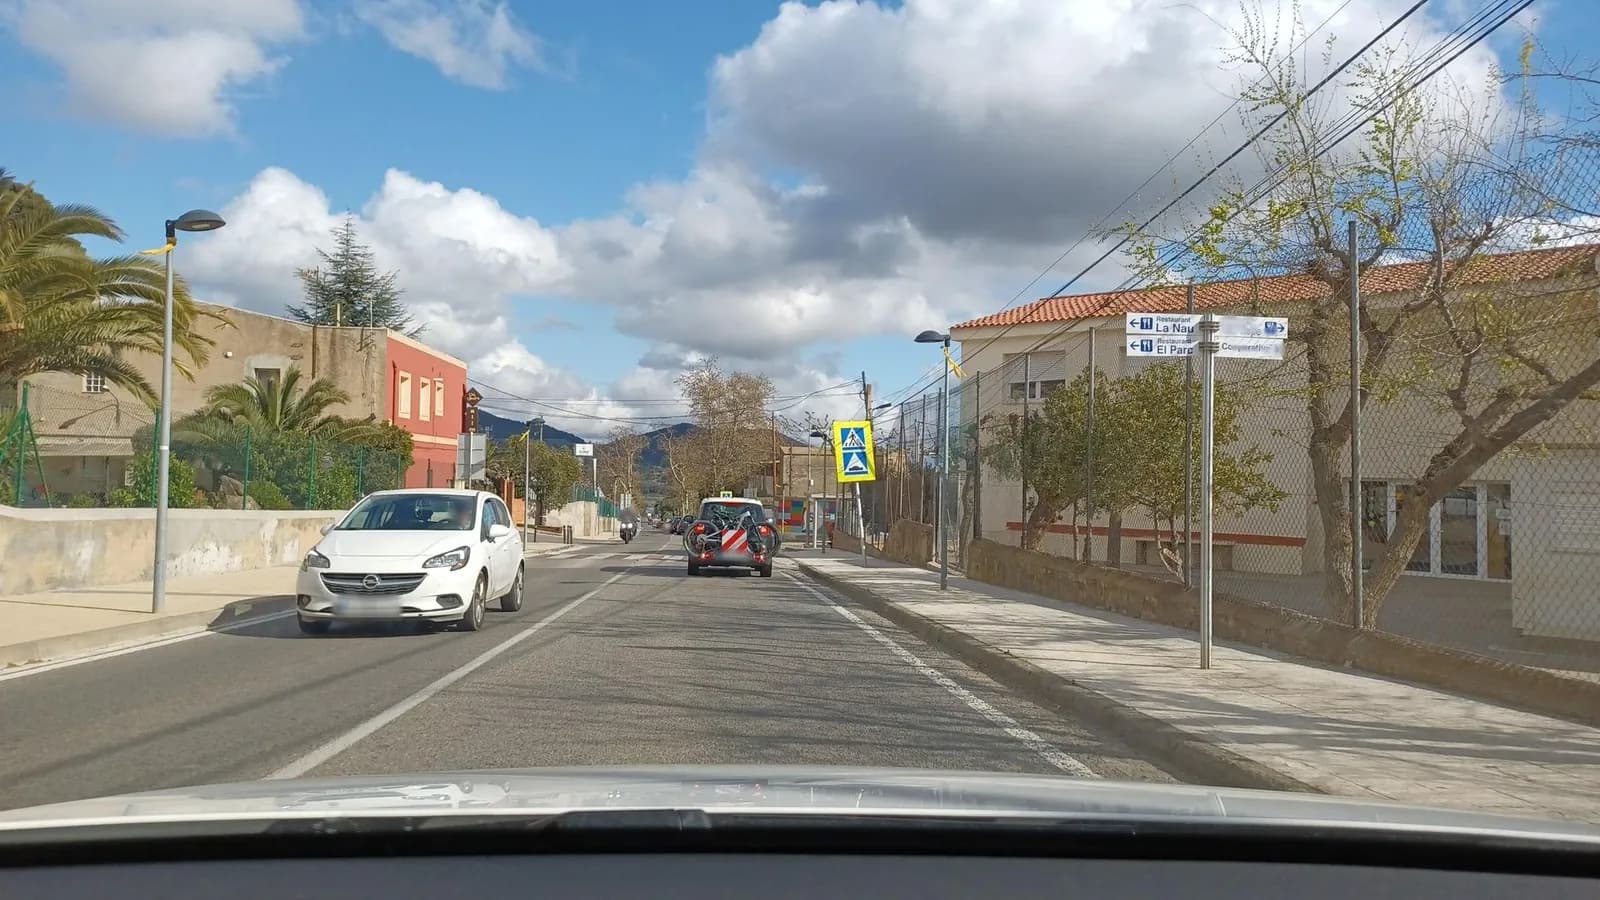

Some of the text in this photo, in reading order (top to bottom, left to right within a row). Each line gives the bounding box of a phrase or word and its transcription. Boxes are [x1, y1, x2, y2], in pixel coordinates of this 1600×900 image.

[1156, 315, 1191, 323] Restaurant
[1156, 323, 1195, 334] La Nau
[1157, 345, 1194, 354] El Parc
